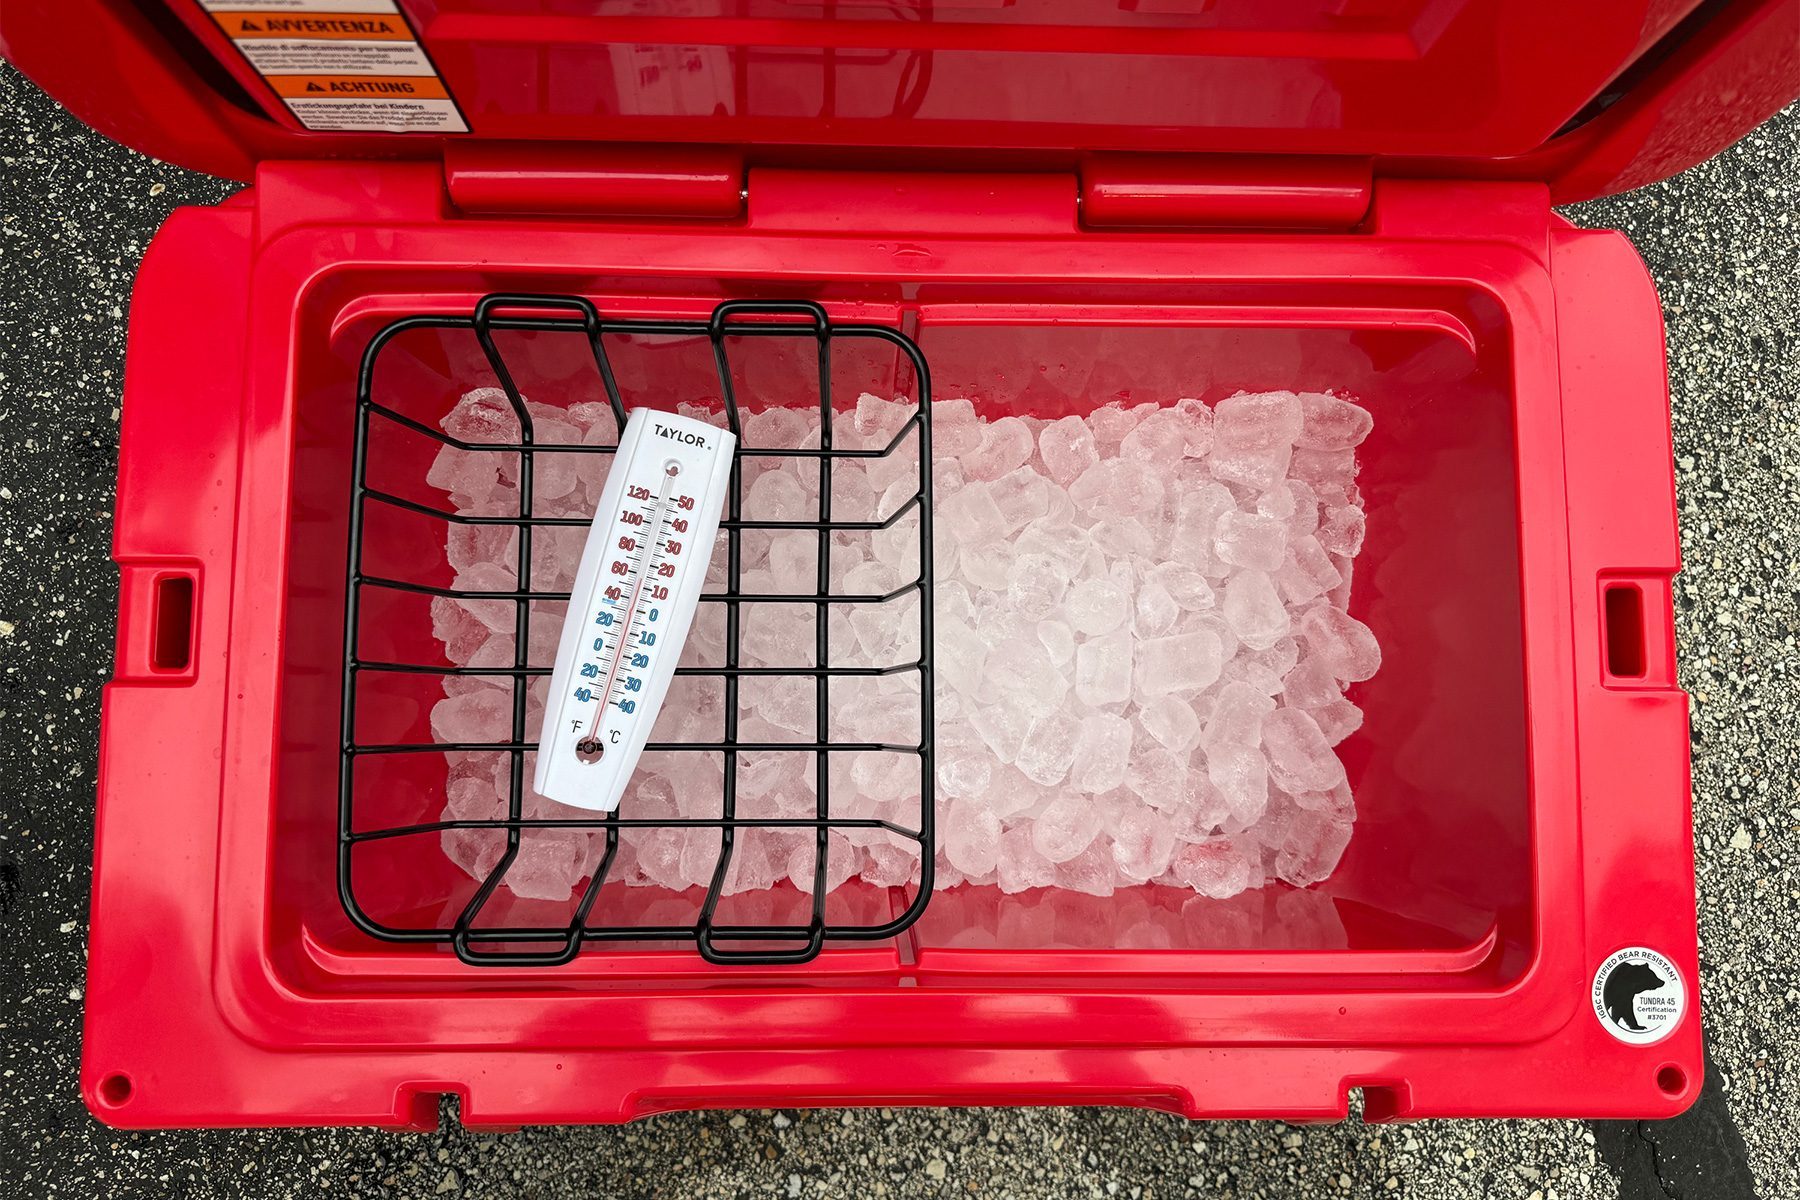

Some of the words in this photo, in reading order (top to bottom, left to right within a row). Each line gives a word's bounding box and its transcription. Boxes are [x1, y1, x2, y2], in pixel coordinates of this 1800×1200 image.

[266, 19, 394, 33] AVVERTENZA
[330, 82, 415, 94] ACHTUNG
[389, 103, 424, 111] Kindern
[655, 424, 706, 448] TAYLOR
[627, 485, 651, 501] 120
[677, 495, 695, 511] 50
[620, 510, 644, 526] 100
[671, 518, 688, 533] 40
[618, 536, 636, 551] 80
[665, 540, 682, 555] 30
[611, 561, 629, 576] 60
[658, 562, 676, 578] 20
[604, 585, 622, 601] 40
[651, 584, 669, 600] 10
[595, 611, 614, 627] 20
[648, 608, 659, 622] 0
[593, 637, 603, 651] 0
[639, 631, 656, 646] 10
[631, 653, 649, 668] 20
[580, 662, 599, 678] 20
[624, 676, 642, 692] 30
[574, 687, 591, 702] 40
[618, 698, 635, 714] 40
[1618, 950, 1640, 960] BEAR
[1641, 951, 1678, 982] RESISTANT
[1595, 958, 1617, 997] CERTIFIED
[1639, 997, 1665, 1005] TUNDRA
[1666, 997, 1676, 1005] 45
[1595, 999, 1607, 1019] IGBC
